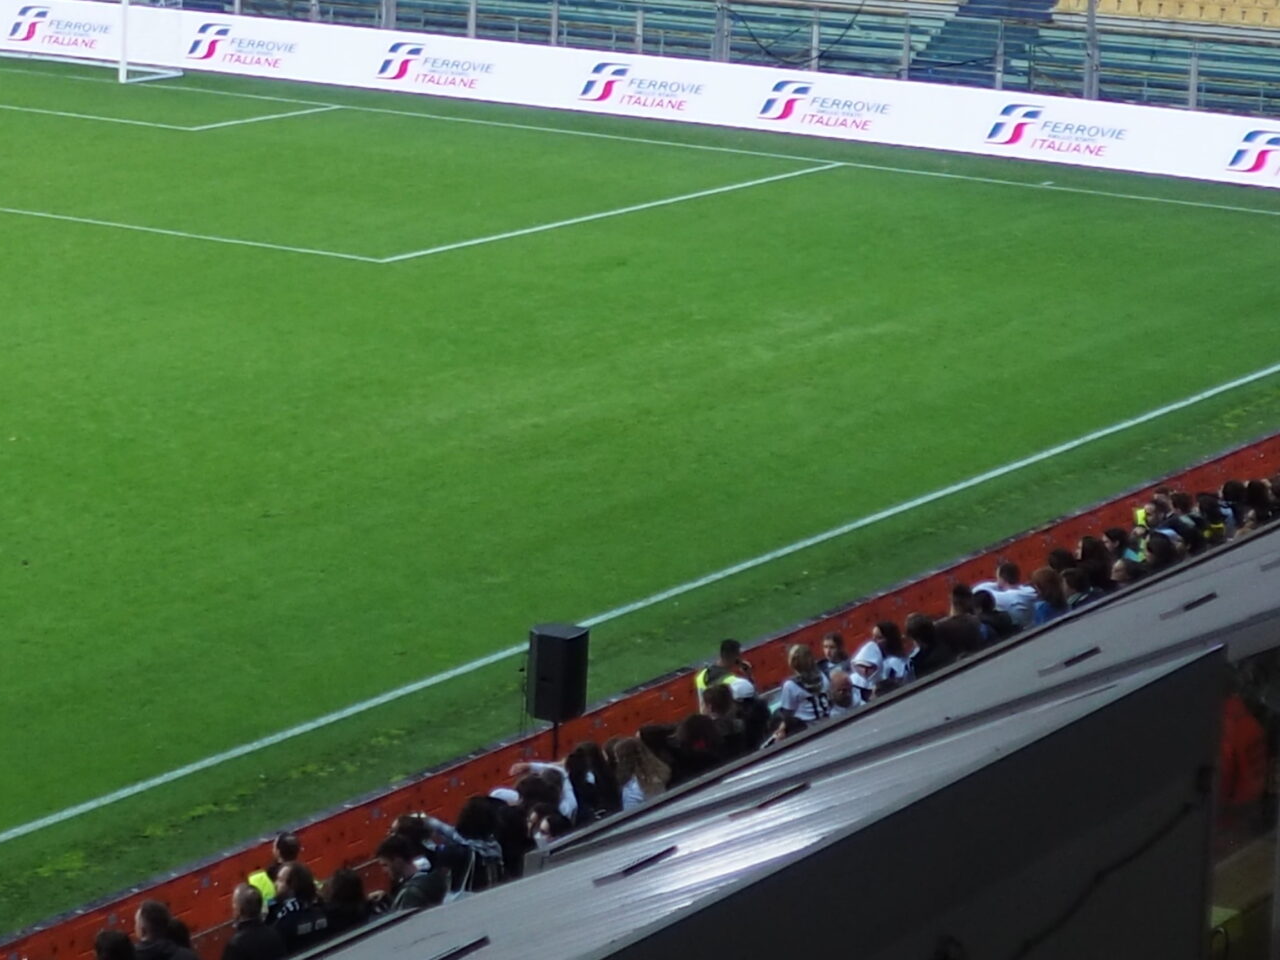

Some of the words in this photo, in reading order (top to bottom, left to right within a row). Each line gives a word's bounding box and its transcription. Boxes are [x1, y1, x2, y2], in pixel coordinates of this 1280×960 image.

[49, 20, 109, 36] FERROVIE
[42, 35, 97, 49] ITALIANE
[231, 38, 295, 55] FERROVIE
[222, 53, 282, 69] ITALIANE
[423, 58, 492, 75] FERROVIE
[415, 74, 478, 89] ITALIANE
[629, 78, 702, 96] FERROVIE
[620, 95, 687, 112] ITALIANE
[810, 97, 889, 116] FERROVIE
[801, 114, 873, 131] ITALIANE
[1041, 121, 1127, 141] FERROVIE
[1031, 139, 1106, 157] ITALIANE
